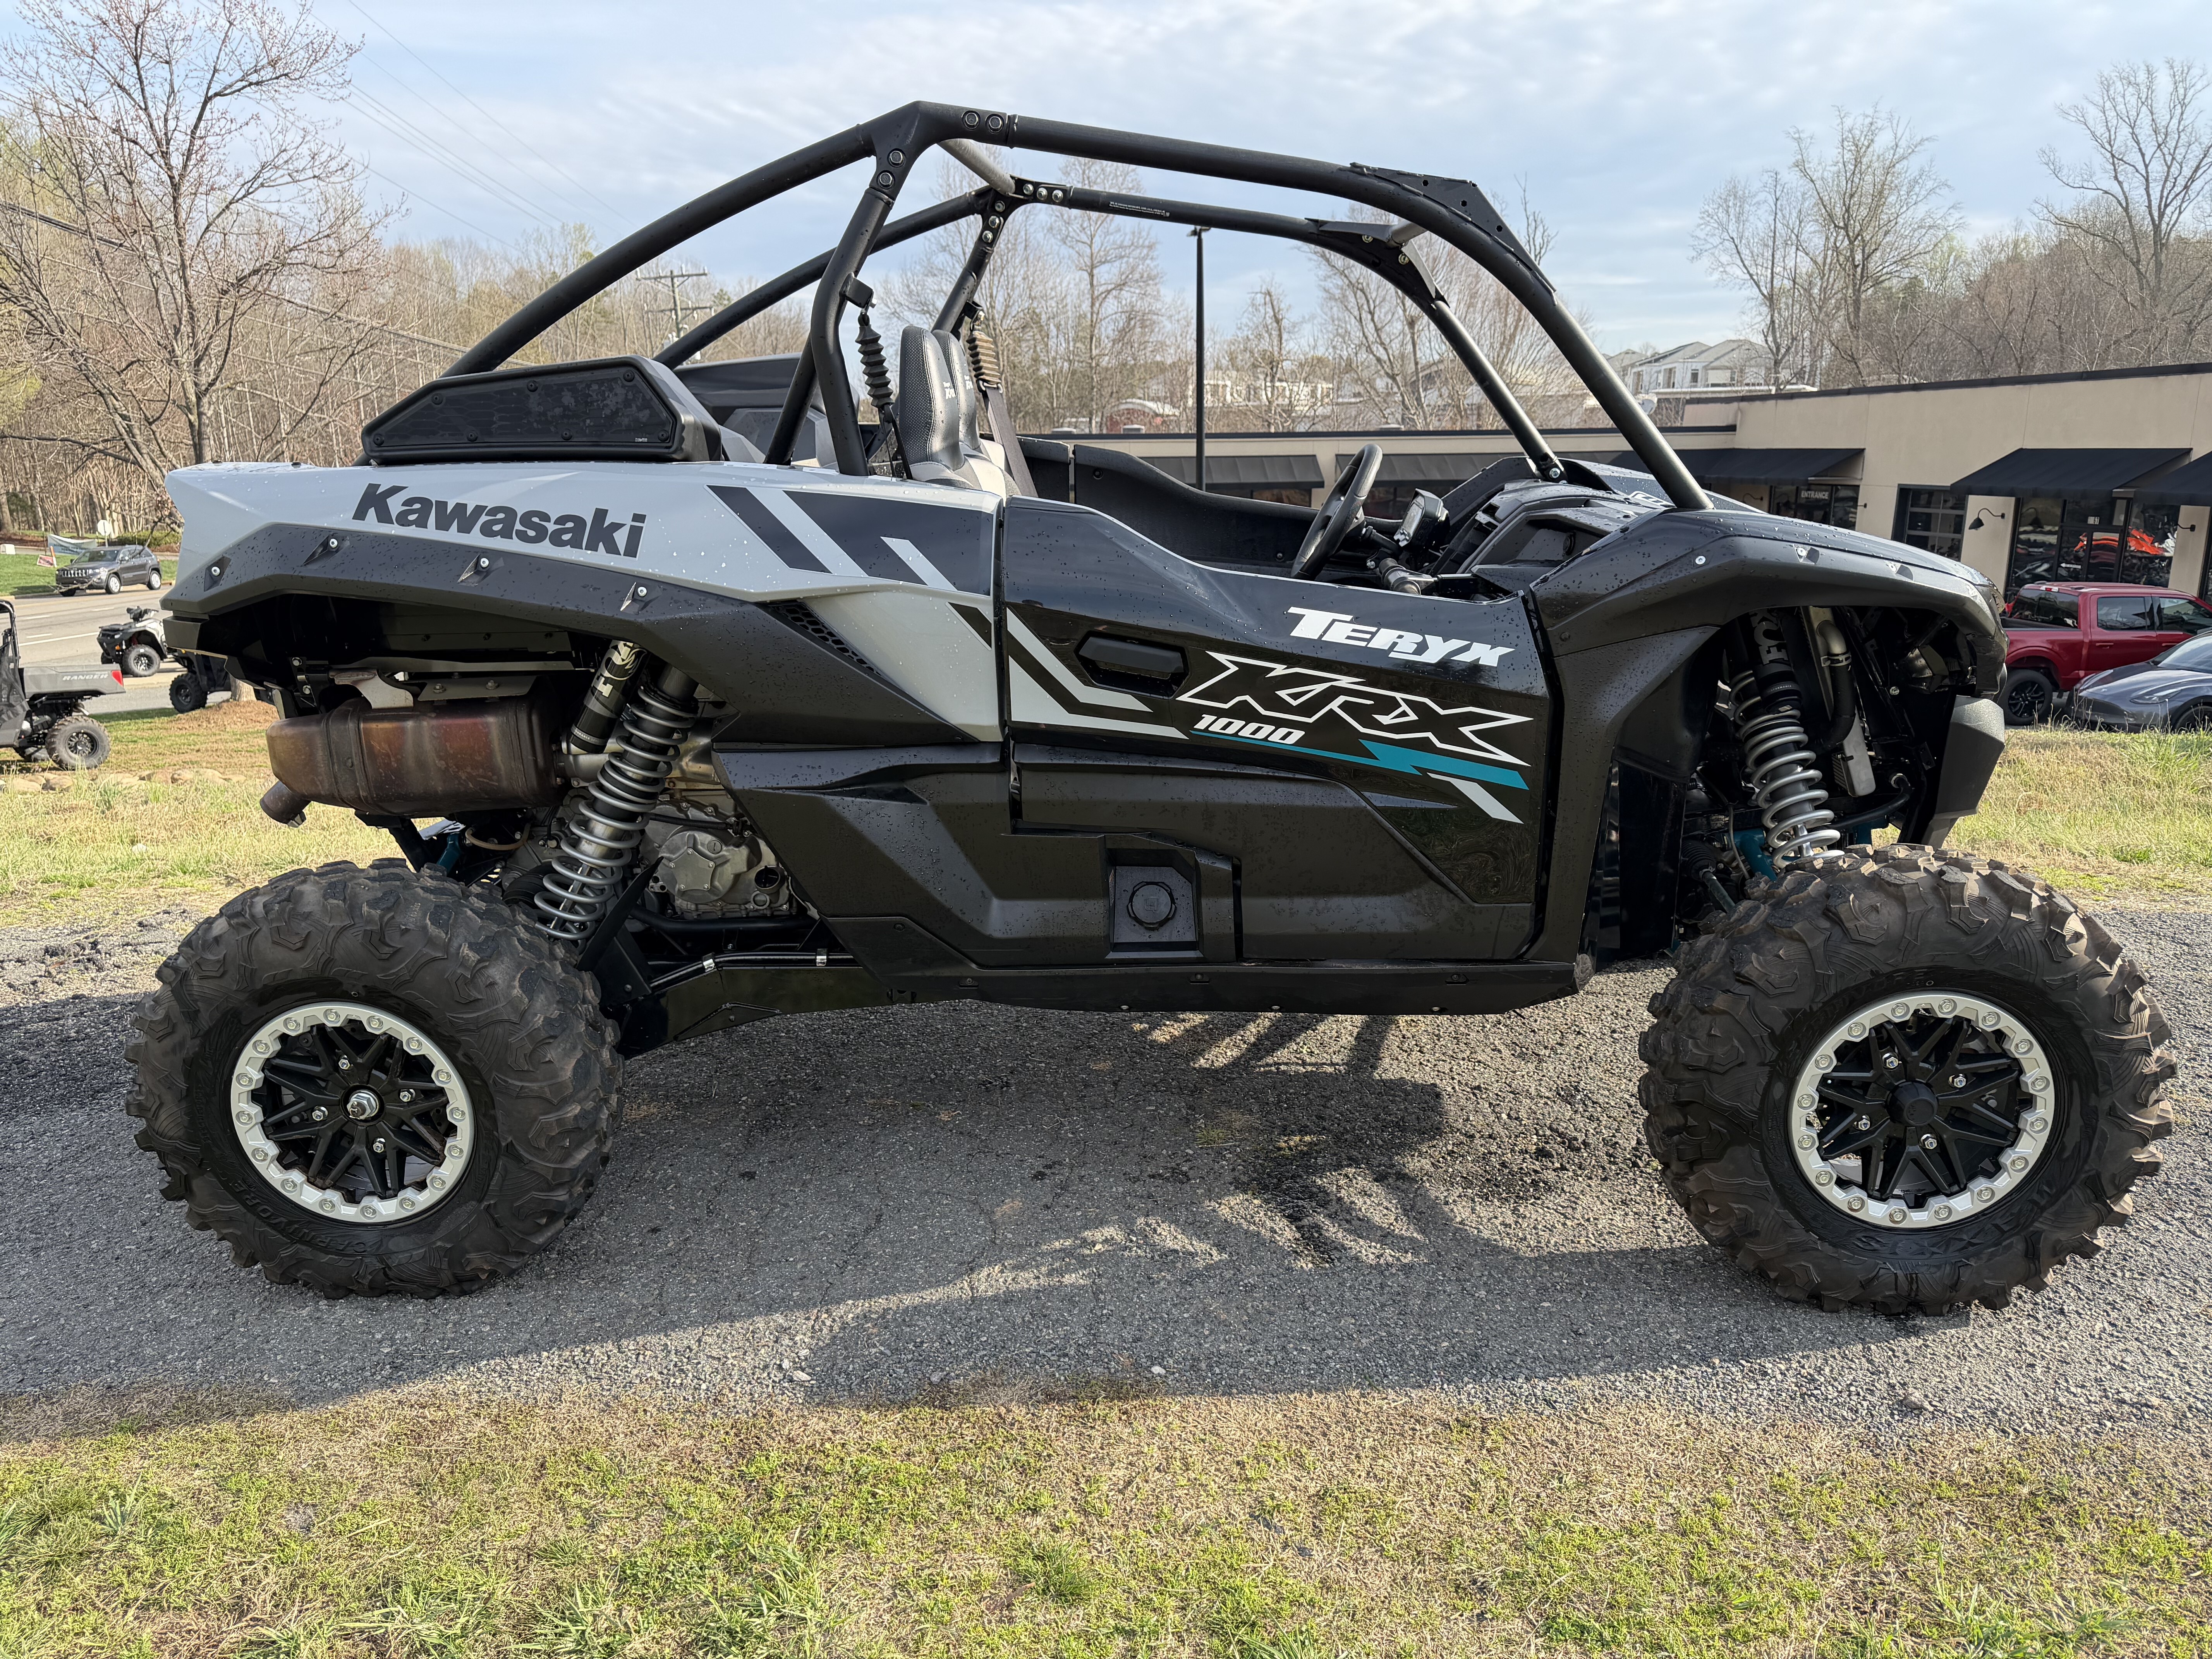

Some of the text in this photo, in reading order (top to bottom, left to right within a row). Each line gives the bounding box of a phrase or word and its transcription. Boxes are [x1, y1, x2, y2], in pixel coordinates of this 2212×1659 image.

[352, 483, 646, 558] Kawasaki
[1801, 490, 1829, 499] ENTRANCE
[1176, 650, 1534, 767] KRX
[1194, 714, 1305, 745] 1000
